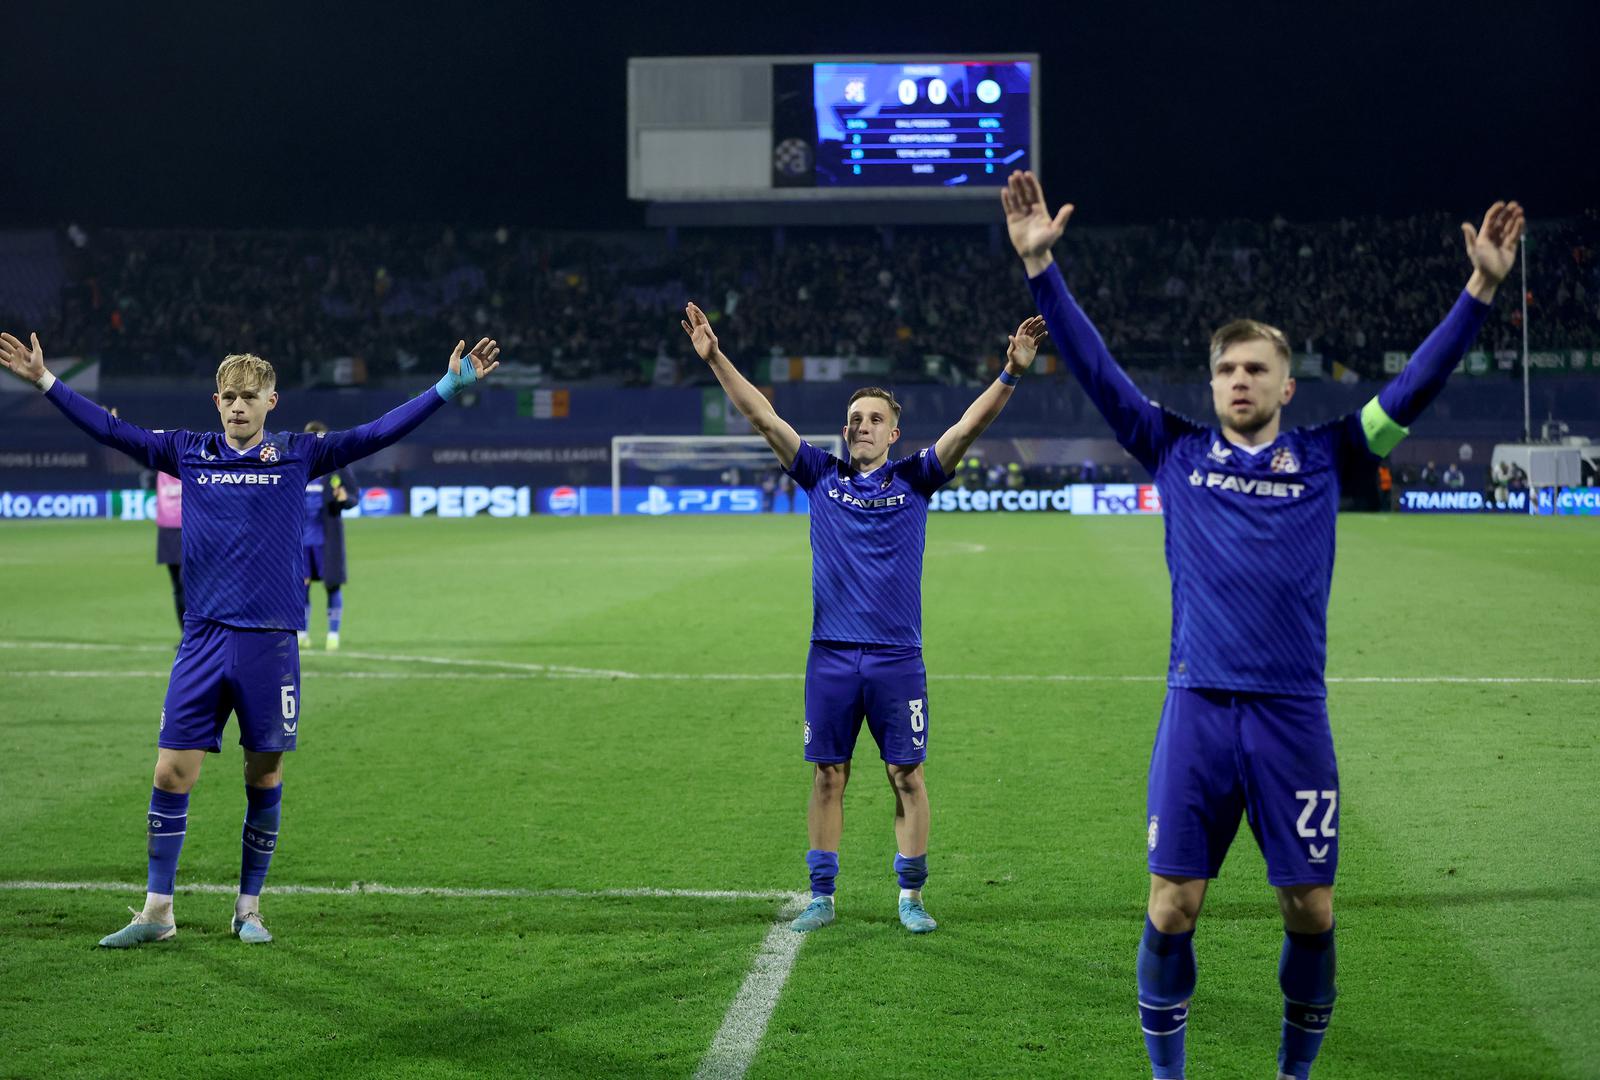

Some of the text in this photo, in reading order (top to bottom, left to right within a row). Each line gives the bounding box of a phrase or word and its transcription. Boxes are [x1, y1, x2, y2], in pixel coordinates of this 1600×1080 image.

[898, 78, 947, 105] 0 0
[211, 473, 282, 485] FAVBET
[1206, 472, 1305, 498] FAVBET
[0, 491, 98, 518] to.com
[410, 485, 531, 517] PEPSI
[679, 488, 759, 511] PS5
[841, 493, 906, 508] FAVBET
[280, 685, 296, 720] 6
[908, 698, 925, 733] 8
[1295, 790, 1337, 838] 22
